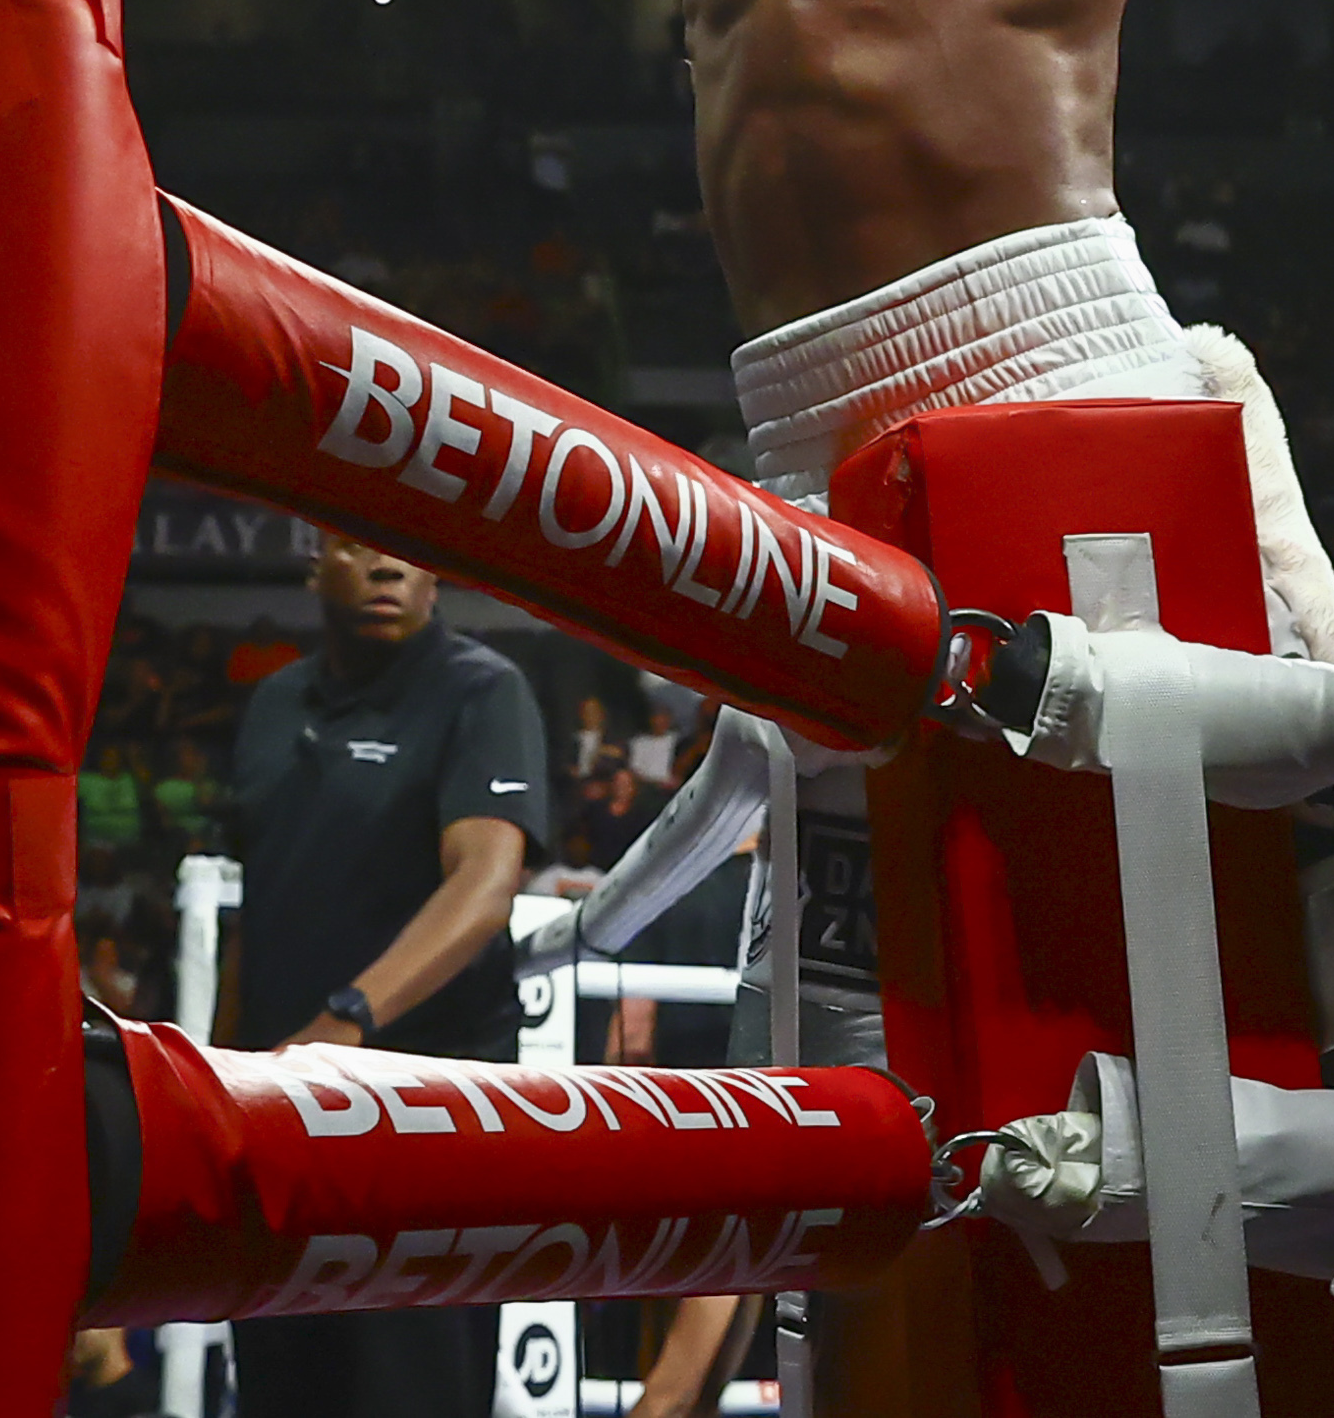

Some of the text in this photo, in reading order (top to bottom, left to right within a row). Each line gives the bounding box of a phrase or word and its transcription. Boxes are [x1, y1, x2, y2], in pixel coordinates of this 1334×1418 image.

[317, 325, 858, 660] BETONLINE
[275, 1052, 841, 1137] BETONLINE
[257, 1208, 844, 1316] BETONLINE
